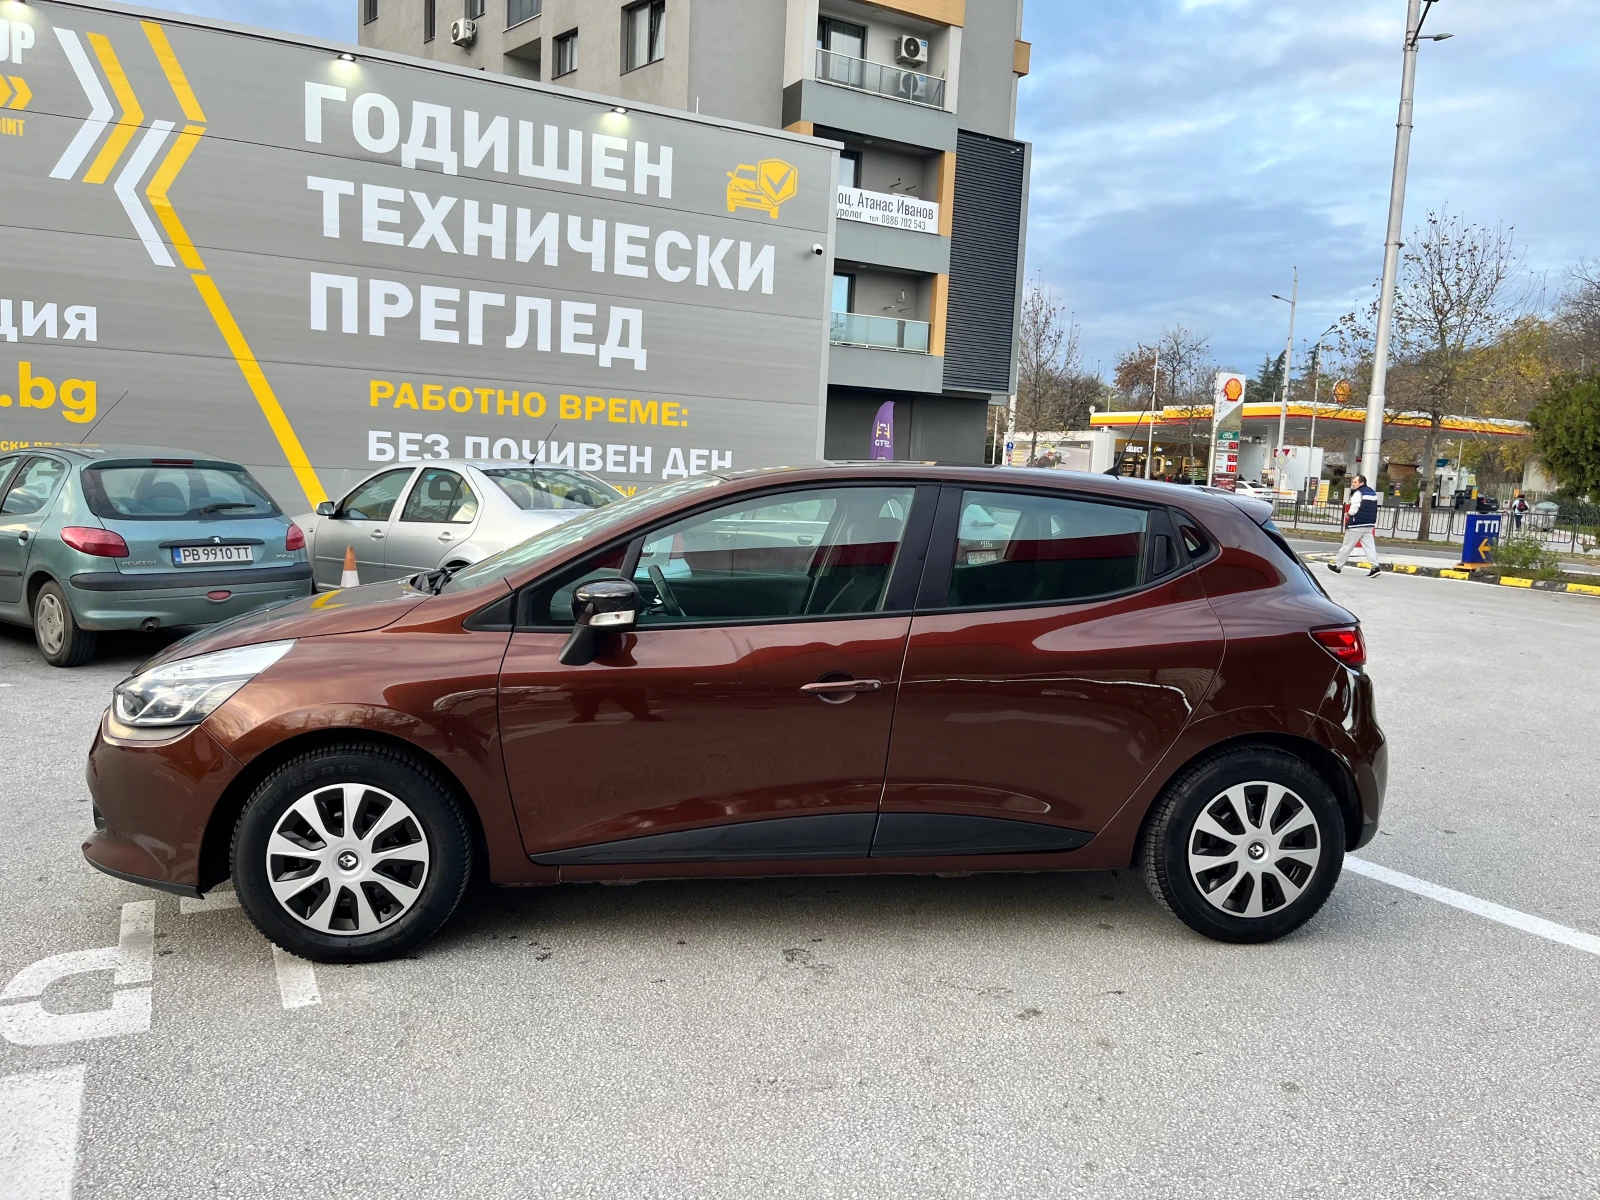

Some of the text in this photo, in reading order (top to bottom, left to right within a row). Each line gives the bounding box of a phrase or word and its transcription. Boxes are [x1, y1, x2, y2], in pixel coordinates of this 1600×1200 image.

[304, 81, 674, 199] ГОДИШЕН
[858, 192, 894, 213] Атанас
[897, 198, 934, 220] Иванов
[881, 214, 899, 226] 0886
[900, 217, 912, 229] 702
[913, 220, 926, 231] 543
[307, 175, 776, 296] ТЕХНИЧЕСКИ
[310, 271, 648, 371] ПРЕГЛЕД
[369, 379, 690, 428] РАБОТНО ВРЕМЕ:
[368, 430, 732, 480] БЕЗ ПОЧИВЕН ДЕН
[1475, 520, 1500, 533] ГТП
[182, 548, 201, 562] PB
[202, 547, 233, 561] 9910
[234, 546, 250, 560] TT
